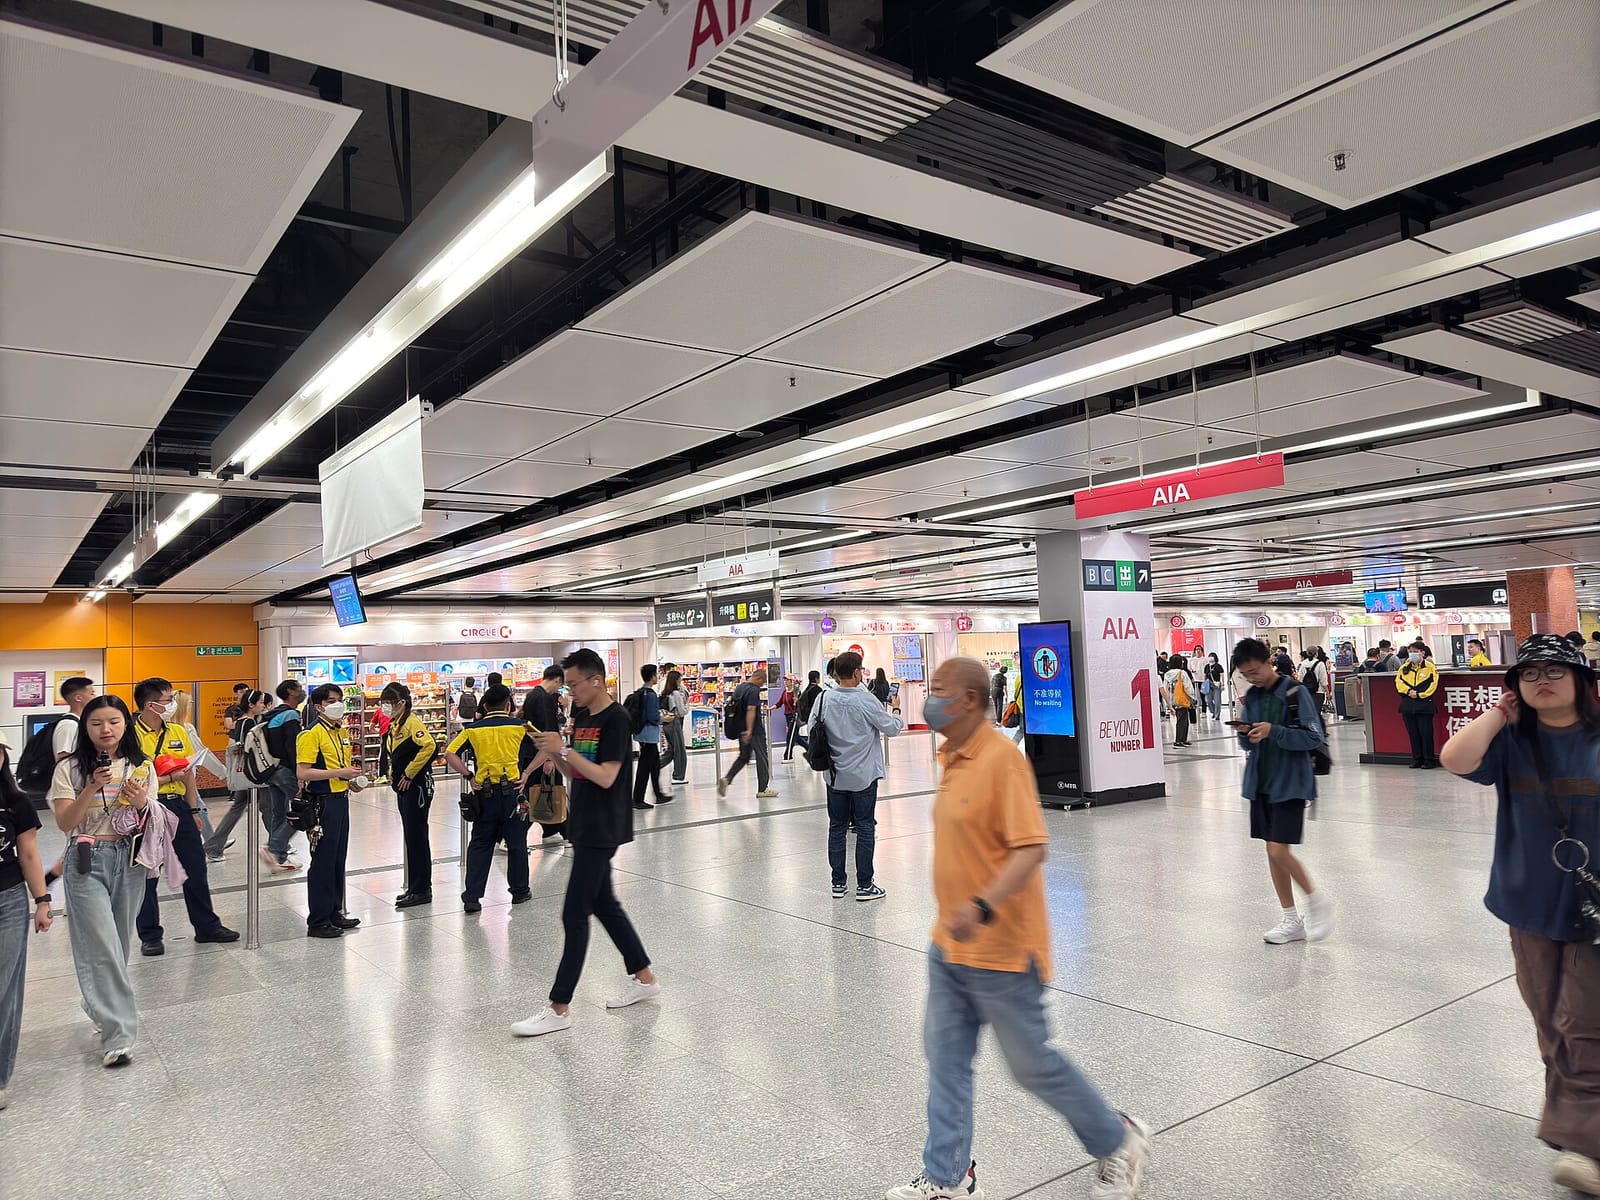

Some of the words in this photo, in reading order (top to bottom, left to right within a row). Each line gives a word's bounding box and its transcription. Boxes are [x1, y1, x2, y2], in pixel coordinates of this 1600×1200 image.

[687, 0, 752, 72] AI
[1152, 482, 1190, 506] AIA
[728, 563, 744, 577] AIA
[1089, 568, 1096, 582] B
[1104, 568, 1112, 582] C
[1119, 565, 1132, 580] 出
[1295, 579, 1313, 589] AIA
[460, 628, 497, 637] CIRCLE
[1102, 617, 1140, 640] AIA
[1042, 699, 1062, 708] waiting
[1110, 739, 1141, 753] NUMBER
[1131, 669, 1154, 749] 1
[1099, 719, 1140, 739] BEYOND
